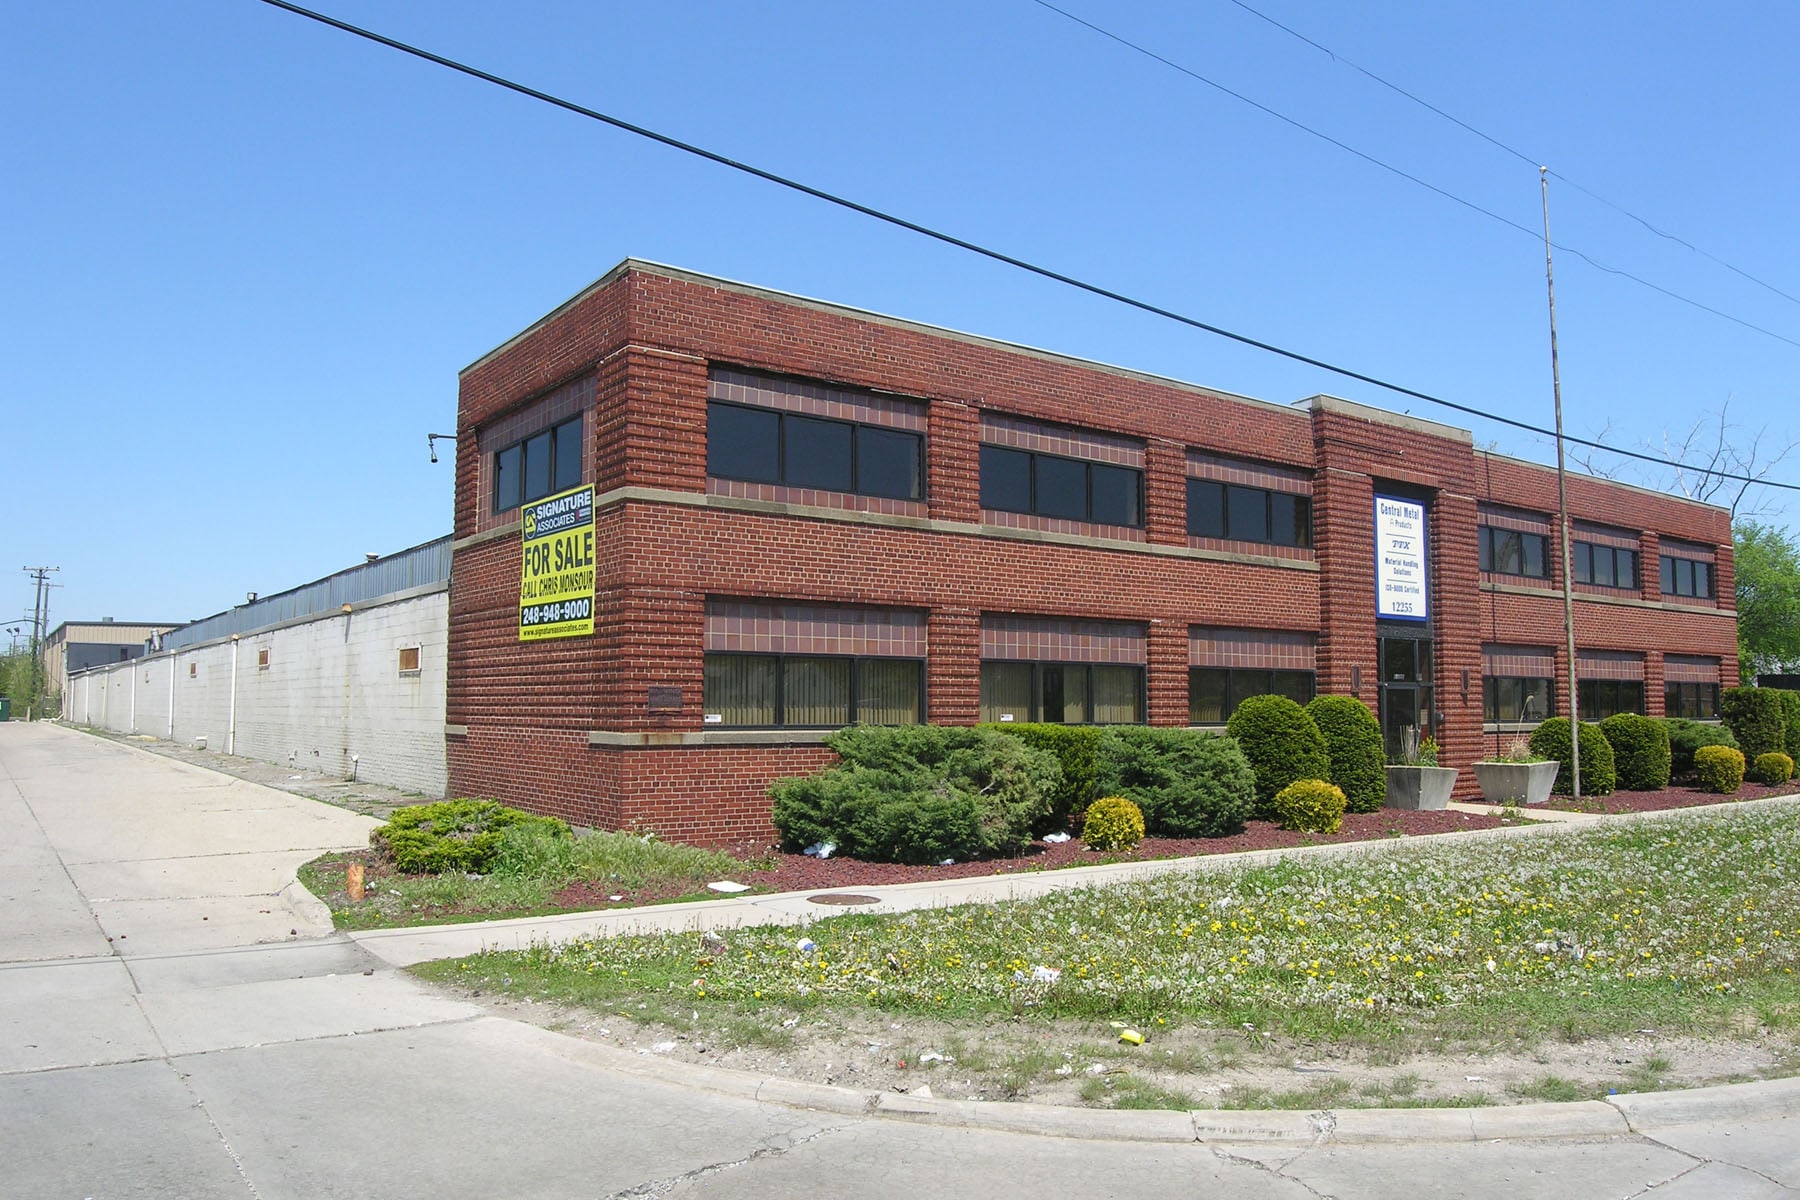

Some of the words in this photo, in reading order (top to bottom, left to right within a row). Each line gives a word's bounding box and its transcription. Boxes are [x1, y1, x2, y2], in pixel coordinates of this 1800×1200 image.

[537, 491, 591, 519] SIGNATURE
[1380, 502, 1402, 517] Central
[1403, 507, 1420, 520] Metal
[537, 512, 575, 533] ASSOCIATES
[524, 542, 551, 578] FOR
[555, 531, 593, 572] SALE
[1392, 539, 1411, 550] TTX
[522, 581, 537, 599] CALL
[539, 576, 558, 597] CHRIS
[559, 570, 593, 594] MONSOUR
[522, 599, 589, 624] 248-948-9000
[1392, 601, 1413, 613] 12255
